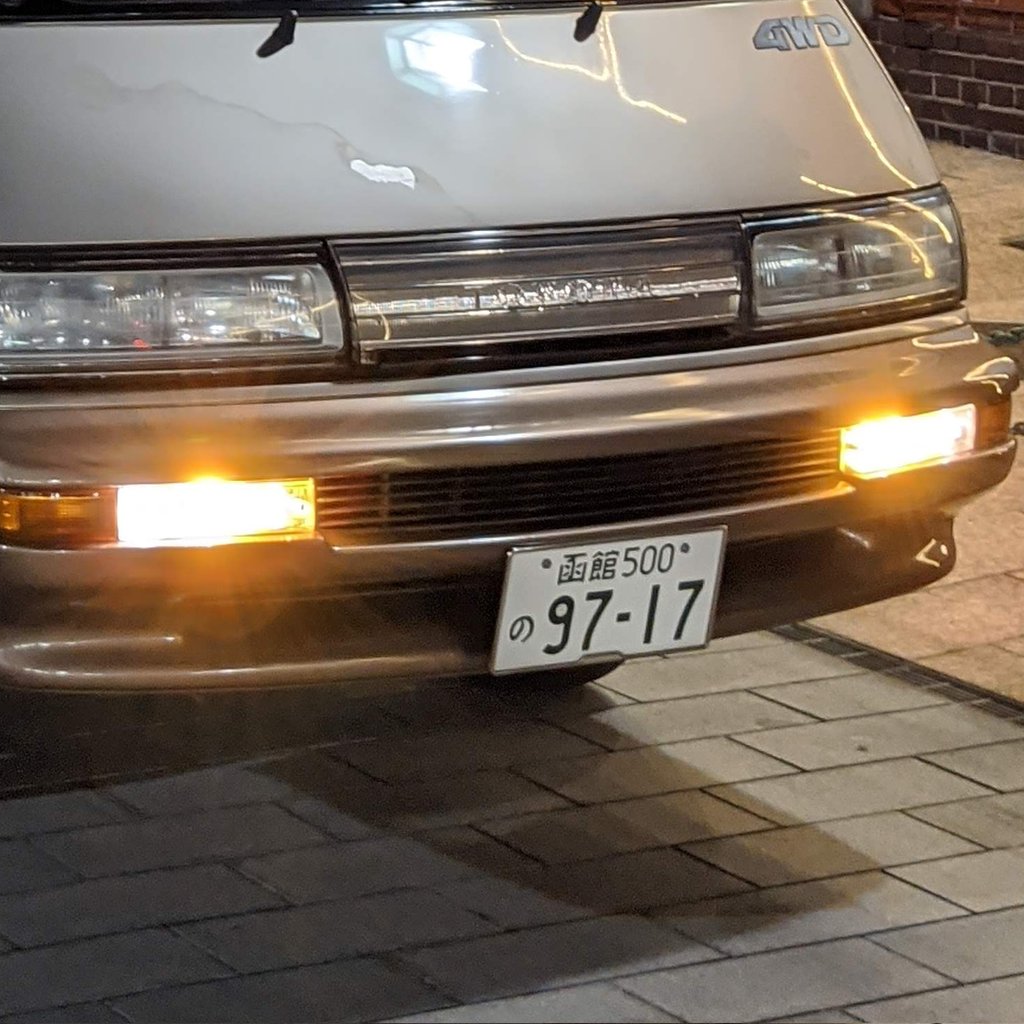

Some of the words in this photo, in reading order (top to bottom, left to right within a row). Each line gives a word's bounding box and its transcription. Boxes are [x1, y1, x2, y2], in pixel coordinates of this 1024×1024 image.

[752, 15, 850, 51] 4WD
[509, 615, 534, 642] の
[543, 579, 705, 655] 97-17
